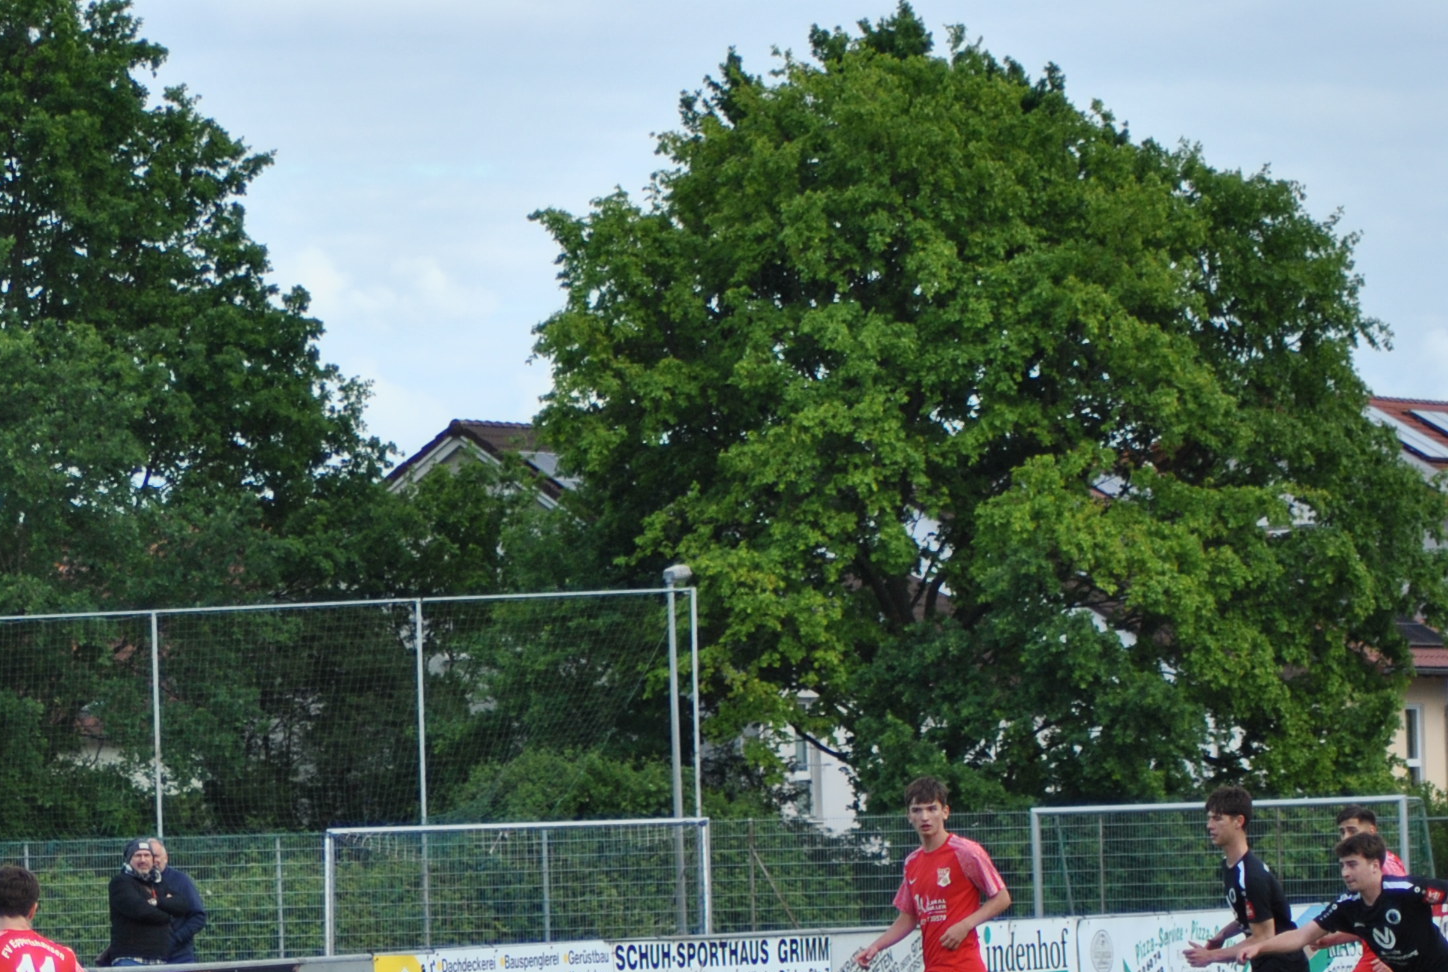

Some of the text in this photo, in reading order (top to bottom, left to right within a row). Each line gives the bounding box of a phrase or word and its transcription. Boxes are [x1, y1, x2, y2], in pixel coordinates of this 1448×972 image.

[1, 944, 13, 959] FV
[568, 948, 609, 966] Gerüstbau
[615, 936, 830, 971] SCHUH-SPORTHAUS GRIMM
[984, 926, 1069, 972] indenhof
[504, 952, 560, 972] Bauspenglerei
